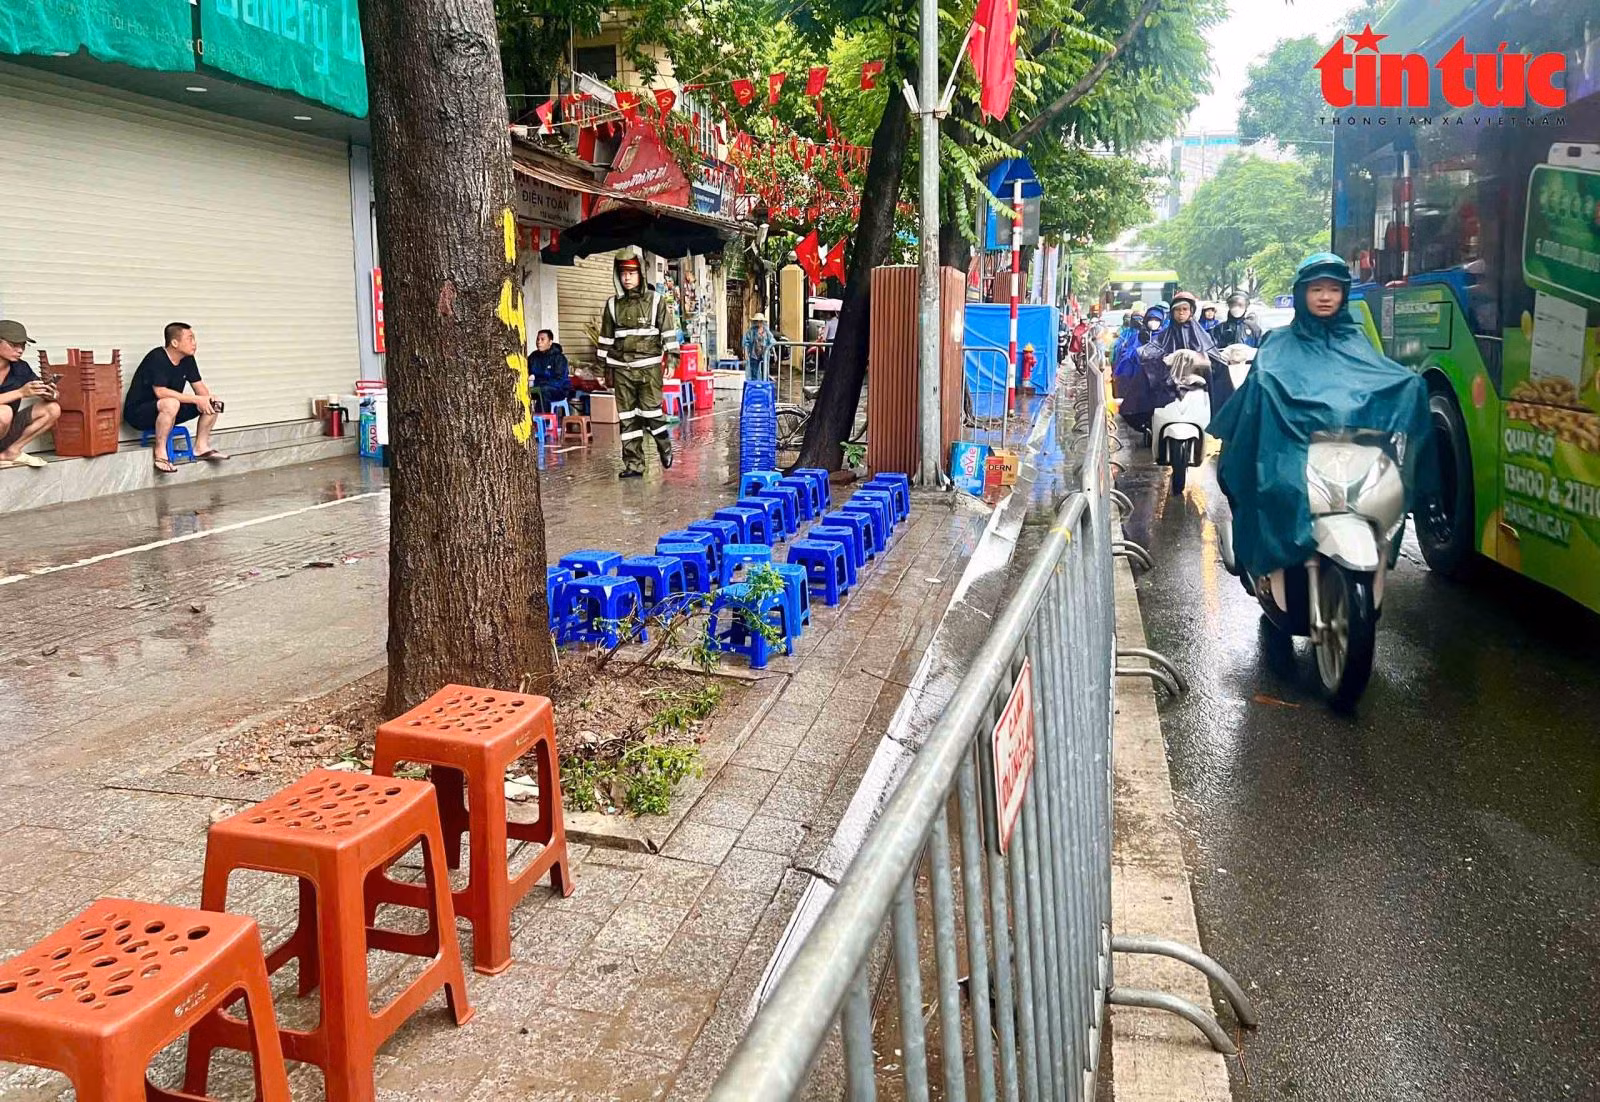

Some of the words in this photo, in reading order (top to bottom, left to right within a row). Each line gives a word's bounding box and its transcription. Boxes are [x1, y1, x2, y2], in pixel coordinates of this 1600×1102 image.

[522, 190, 543, 207] ĐIỆN
[546, 196, 569, 212] TOÁN
[1505, 428, 1535, 453] QUAY
[1504, 462, 1544, 499] 13H00
[1548, 477, 1560, 504] &
